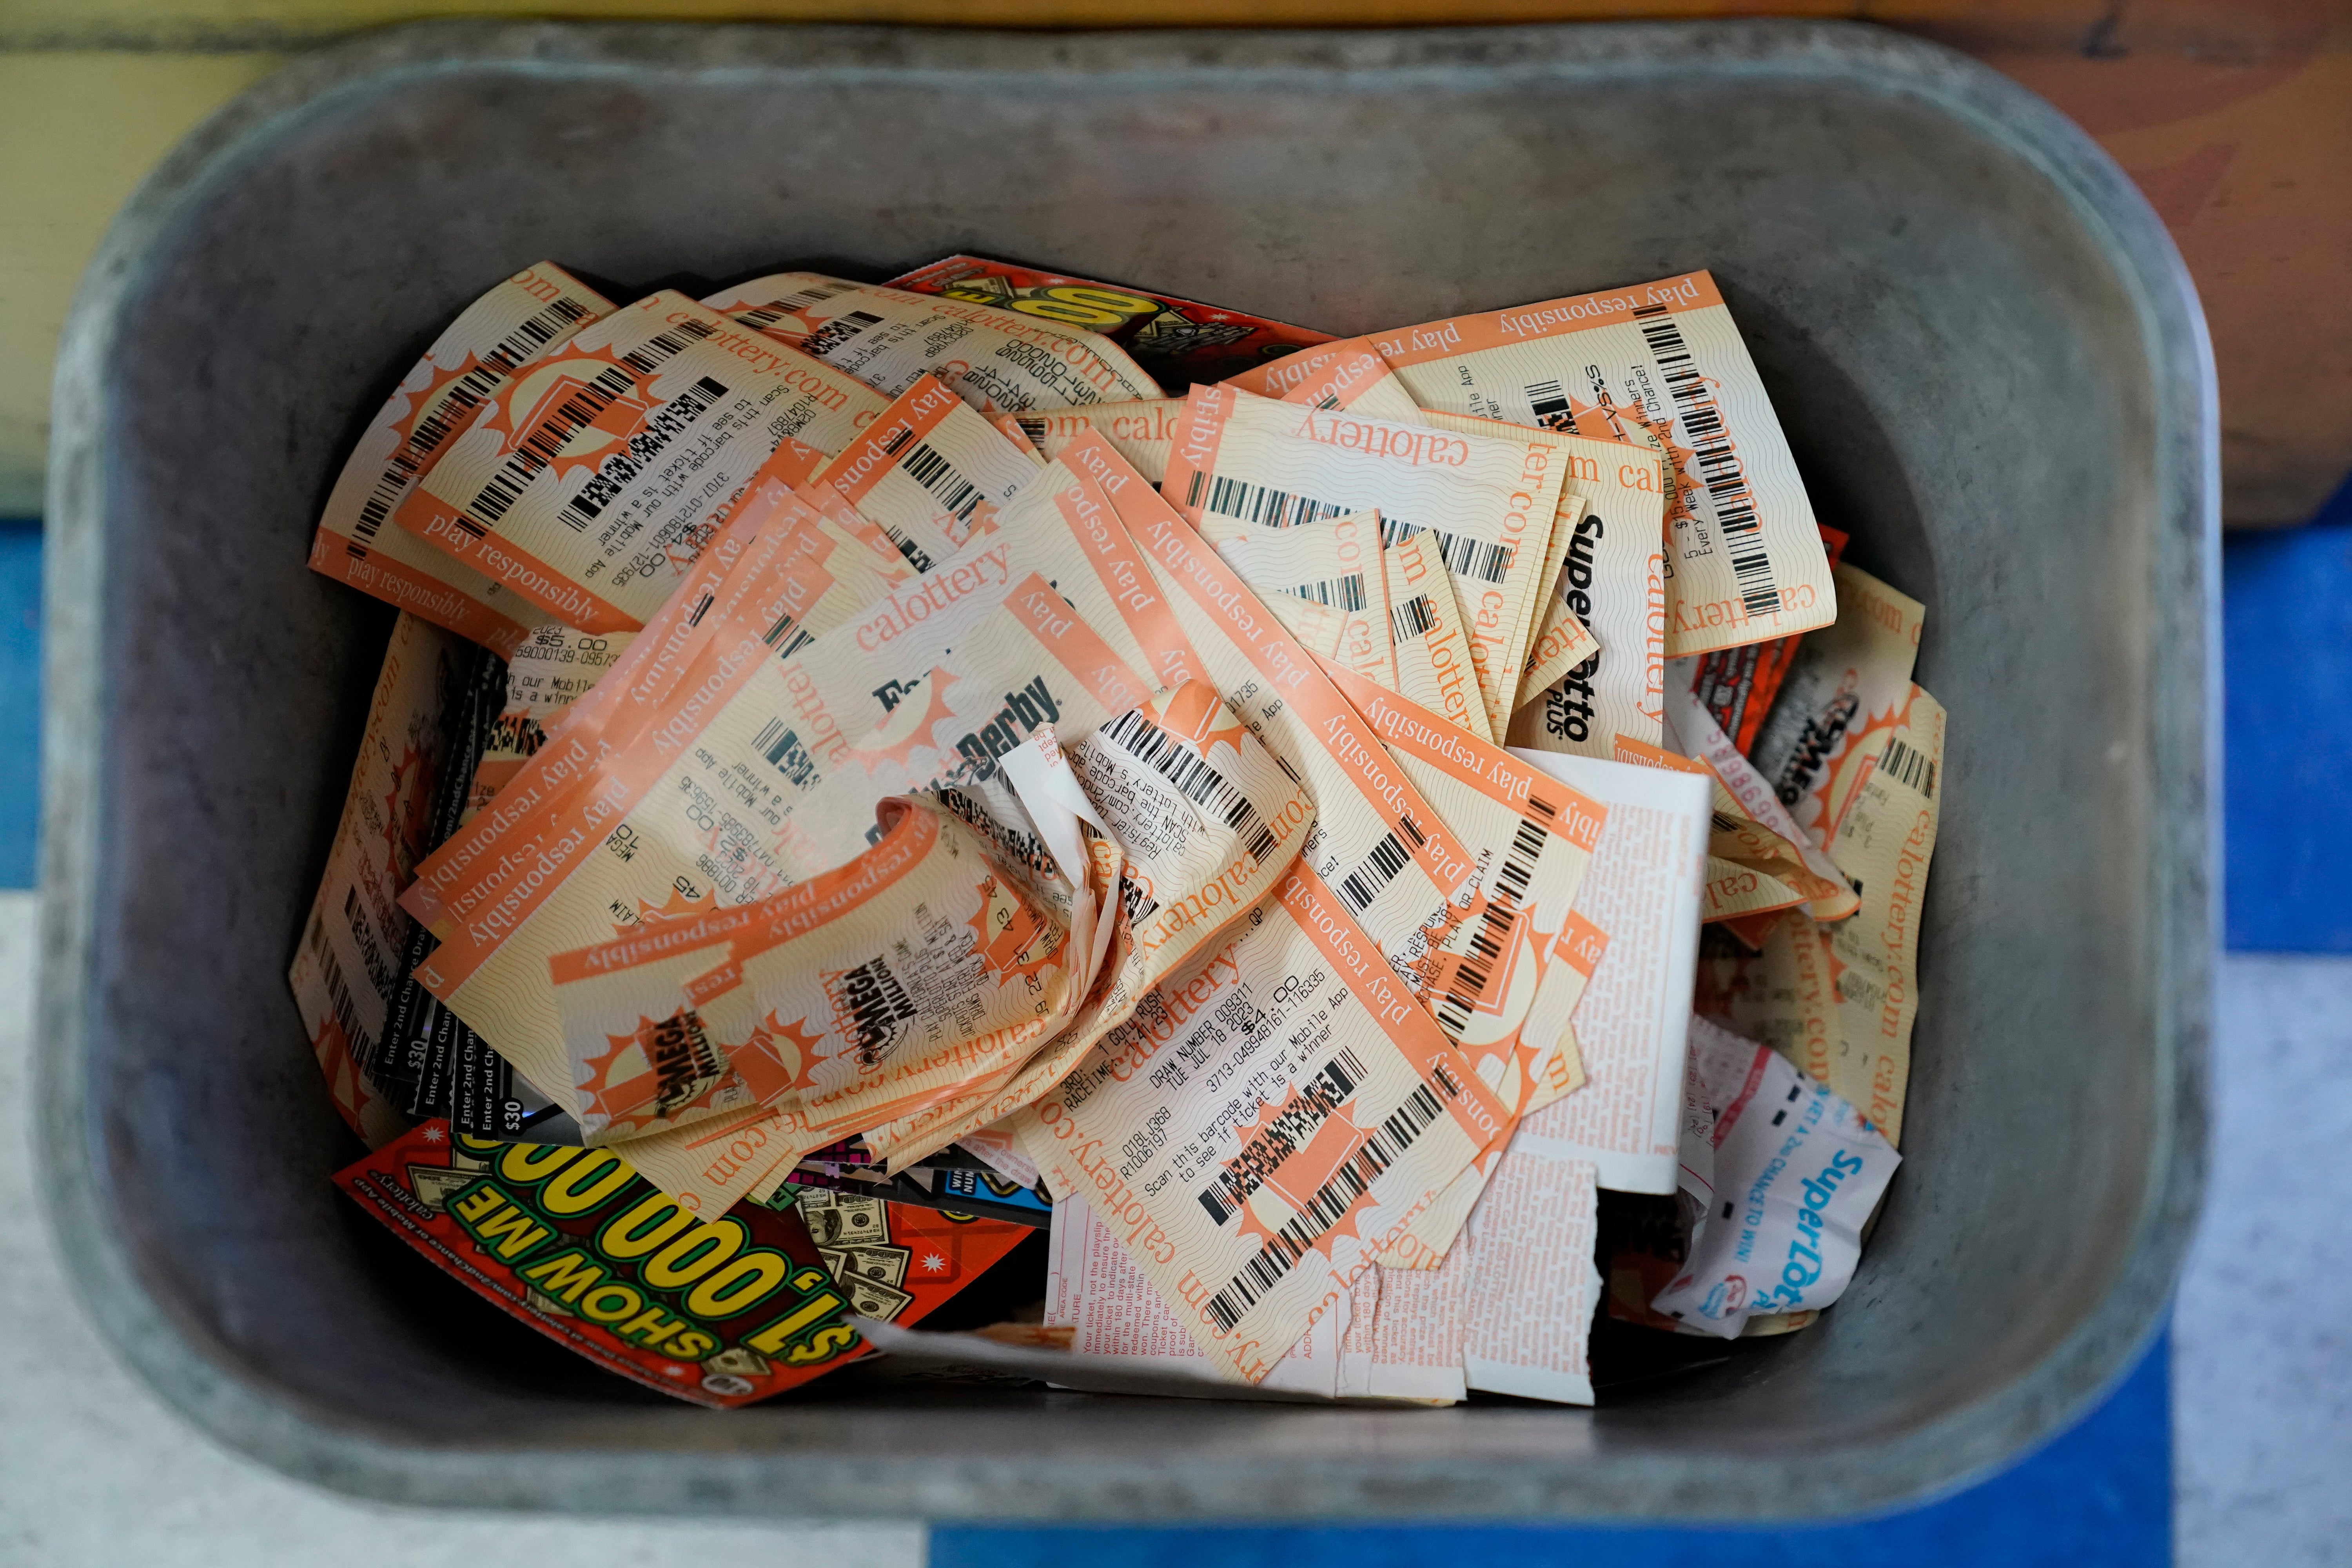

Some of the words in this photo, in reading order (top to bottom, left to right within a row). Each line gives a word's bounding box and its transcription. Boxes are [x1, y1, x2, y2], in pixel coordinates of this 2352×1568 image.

[1642, 277, 1699, 312] play
[1497, 289, 1638, 340] responsibly
[867, 330, 888, 347] see
[888, 324, 916, 347] this
[1411, 323, 1461, 351] play
[843, 343, 887, 377] barcode
[733, 396, 750, 414] to
[758, 380, 790, 412] Scan
[1624, 377, 1651, 430] Winners
[1631, 361, 1662, 414] Chance!
[711, 409, 734, 433] see
[730, 403, 762, 435] this
[1655, 416, 1672, 441] 2nd
[686, 428, 734, 476] barcode
[1294, 404, 1471, 473] calottery
[656, 446, 695, 486] ticket
[1666, 445, 1686, 476] with
[641, 483, 658, 501] is
[661, 471, 690, 500] with
[1679, 481, 1697, 512] Week
[642, 497, 663, 519] our
[595, 508, 633, 548] winner
[603, 518, 643, 560] Mobile
[1690, 516, 1713, 556] Every
[424, 508, 482, 558] play
[475, 539, 603, 626] responsibly
[583, 557, 606, 581] App
[1099, 552, 1158, 617] play
[1142, 512, 1273, 644] responsibly
[342, 554, 381, 591] play
[376, 559, 474, 633] responsibly
[754, 576, 810, 633] play
[845, 533, 1022, 662] calottery
[1014, 584, 1074, 644] play
[535, 633, 608, 652] $5.00
[521, 675, 544, 688] our
[1253, 635, 1312, 693] play
[644, 625, 771, 759] responsibly
[956, 673, 1054, 779] Derby
[1357, 693, 1492, 775] responsibly
[532, 737, 592, 799] play
[691, 746, 718, 771] App
[1076, 740, 1118, 774] Mobile
[1317, 709, 1431, 837] responsibly
[714, 766, 758, 808] Mobile
[730, 759, 771, 797] winner
[1086, 764, 1137, 804] barcode
[1117, 768, 1179, 816] Lottery's
[1482, 759, 1535, 805] play
[571, 773, 634, 838] play
[1135, 798, 1161, 821] the
[1178, 810, 1209, 836] with
[1107, 816, 1163, 861] Register
[1159, 815, 1191, 842] SCAN
[603, 833, 635, 863] MEGA
[1412, 829, 1467, 886] play
[460, 820, 588, 953] responsibly
[1464, 847, 1497, 890] CLAIM
[1456, 892, 1475, 912] OR
[581, 902, 750, 975] responsibly
[1439, 914, 1468, 949] PLAY
[1407, 952, 1434, 986] MUST
[1426, 932, 1444, 950] BE
[399, 956, 420, 1004] Chance
[922, 971, 953, 1022] SUPERLOTTO
[1362, 971, 1413, 1025] play
[393, 1004, 408, 1030] 2nd
[951, 1000, 976, 1038] JACKPOTS
[1099, 940, 1253, 1091] calottery
[1237, 973, 1303, 1037] $4.00
[384, 1030, 402, 1066] Enter
[1058, 1065, 1089, 1095] 3RD:
[1133, 988, 1165, 1020] RUSH
[1149, 1058, 1180, 1089] DRAW
[1174, 1019, 1218, 1062] NUMBER
[1212, 982, 1255, 1024] 009311
[1166, 1067, 1191, 1091] TUE
[1187, 1046, 1212, 1070] JUL
[1209, 1028, 1229, 1047] 18
[1224, 1000, 1256, 1032] 2023
[1201, 967, 1330, 1093] 3713-049948161-116335
[432, 1045, 445, 1069] 2nd
[461, 1062, 478, 1089] 2nd
[1062, 1054, 1120, 1112] RACETIME:
[1123, 1005, 1170, 1052] 1:41.23
[425, 1071, 441, 1105] Enter
[481, 1068, 497, 1094] 2nd
[1143, 1166, 1174, 1198] Scan
[1170, 1139, 1201, 1169] this
[1196, 1096, 1244, 1143] barcode
[1240, 1069, 1270, 1100] with
[1268, 1049, 1291, 1071] our
[1287, 1007, 1330, 1049] Mobile
[1327, 985, 1352, 1011] App
[456, 1089, 475, 1125] Enter
[478, 1096, 497, 1131] Enter
[501, 1100, 524, 1132] $30
[1178, 1165, 1196, 1183] to
[1194, 1145, 1218, 1169] see
[1216, 1127, 1234, 1144] if
[1230, 1089, 1272, 1129] ticket
[1270, 1071, 1287, 1089] is
[1294, 1022, 1336, 1063] winner
[1118, 1128, 1171, 1180] R1006197
[369, 1169, 440, 1223] calottery
[457, 1184, 550, 1259] ME
[1093, 1219, 1104, 1257] playslip
[1090, 1260, 1099, 1276] the
[1108, 1250, 1118, 1289] indicate
[1118, 1252, 1127, 1275] after
[526, 1251, 716, 1359] SHOW
[1089, 1279, 1097, 1296] not
[1093, 1295, 1107, 1354] immediately
[1100, 1244, 1110, 1279] ensure
[1116, 1278, 1126, 1301] days
[1125, 1263, 1136, 1316] multi-state
[1135, 1274, 1144, 1301] within
[1085, 1298, 1096, 1328] ticket,
[1104, 1303, 1114, 1331] ticket
[1115, 1304, 1123, 1322] 180
[1123, 1321, 1131, 1336] the
[1130, 1306, 1141, 1356] redeemed
[1142, 1299, 1152, 1328] There
[1083, 1331, 1093, 1354] Your
[1103, 1333, 1112, 1355] your
[1112, 1325, 1121, 1354] within
[1121, 1342, 1129, 1355] for
[1150, 1313, 1160, 1357] coupons,
[1158, 1325, 1167, 1356] Ticket
[1168, 1330, 1177, 1357] proof
